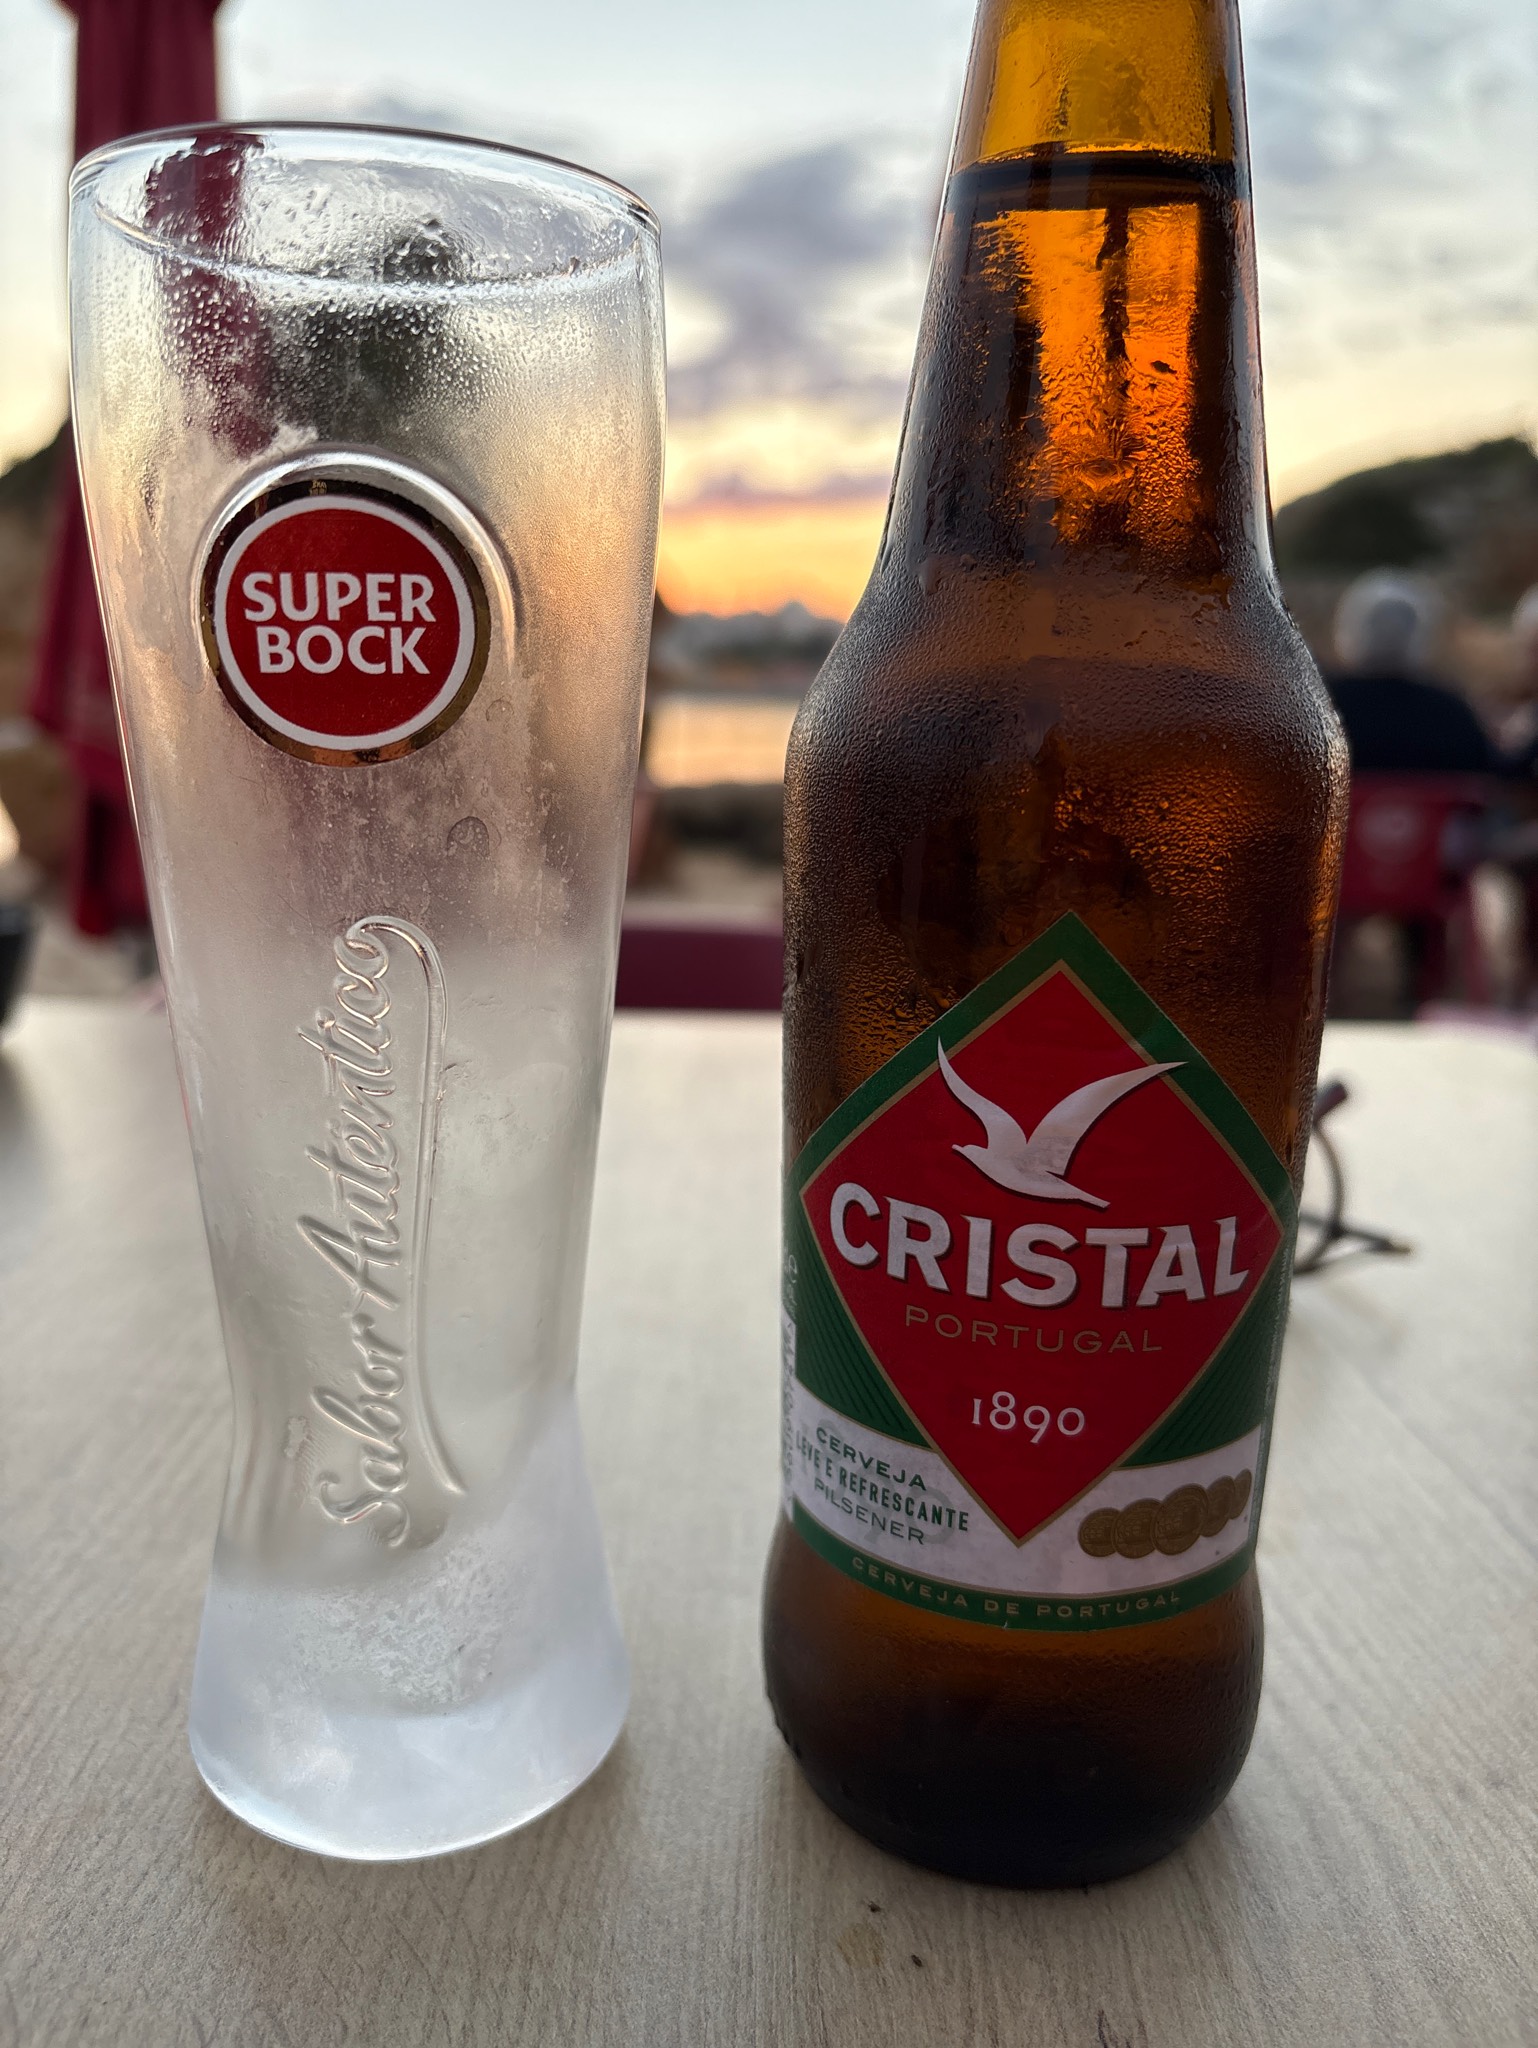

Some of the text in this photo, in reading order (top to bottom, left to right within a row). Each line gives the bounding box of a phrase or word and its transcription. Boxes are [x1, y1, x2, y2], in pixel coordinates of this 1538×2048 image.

[242, 571, 436, 622] SUPER
[256, 625, 430, 675] BOCK
[829, 1181, 1250, 1309] CRISTAL
[905, 1304, 1162, 1354] PORTUGAL
[310, 1312, 410, 1547] Sabor
[970, 1390, 1085, 1444] 1890
[796, 1430, 970, 1532] LEVE E REFRESCANTE
[815, 1427, 927, 1492] CERVEJA
[814, 1478, 925, 1546] PILSENER
[851, 1555, 1181, 1618] CERVEJA DE PORTUGAL
